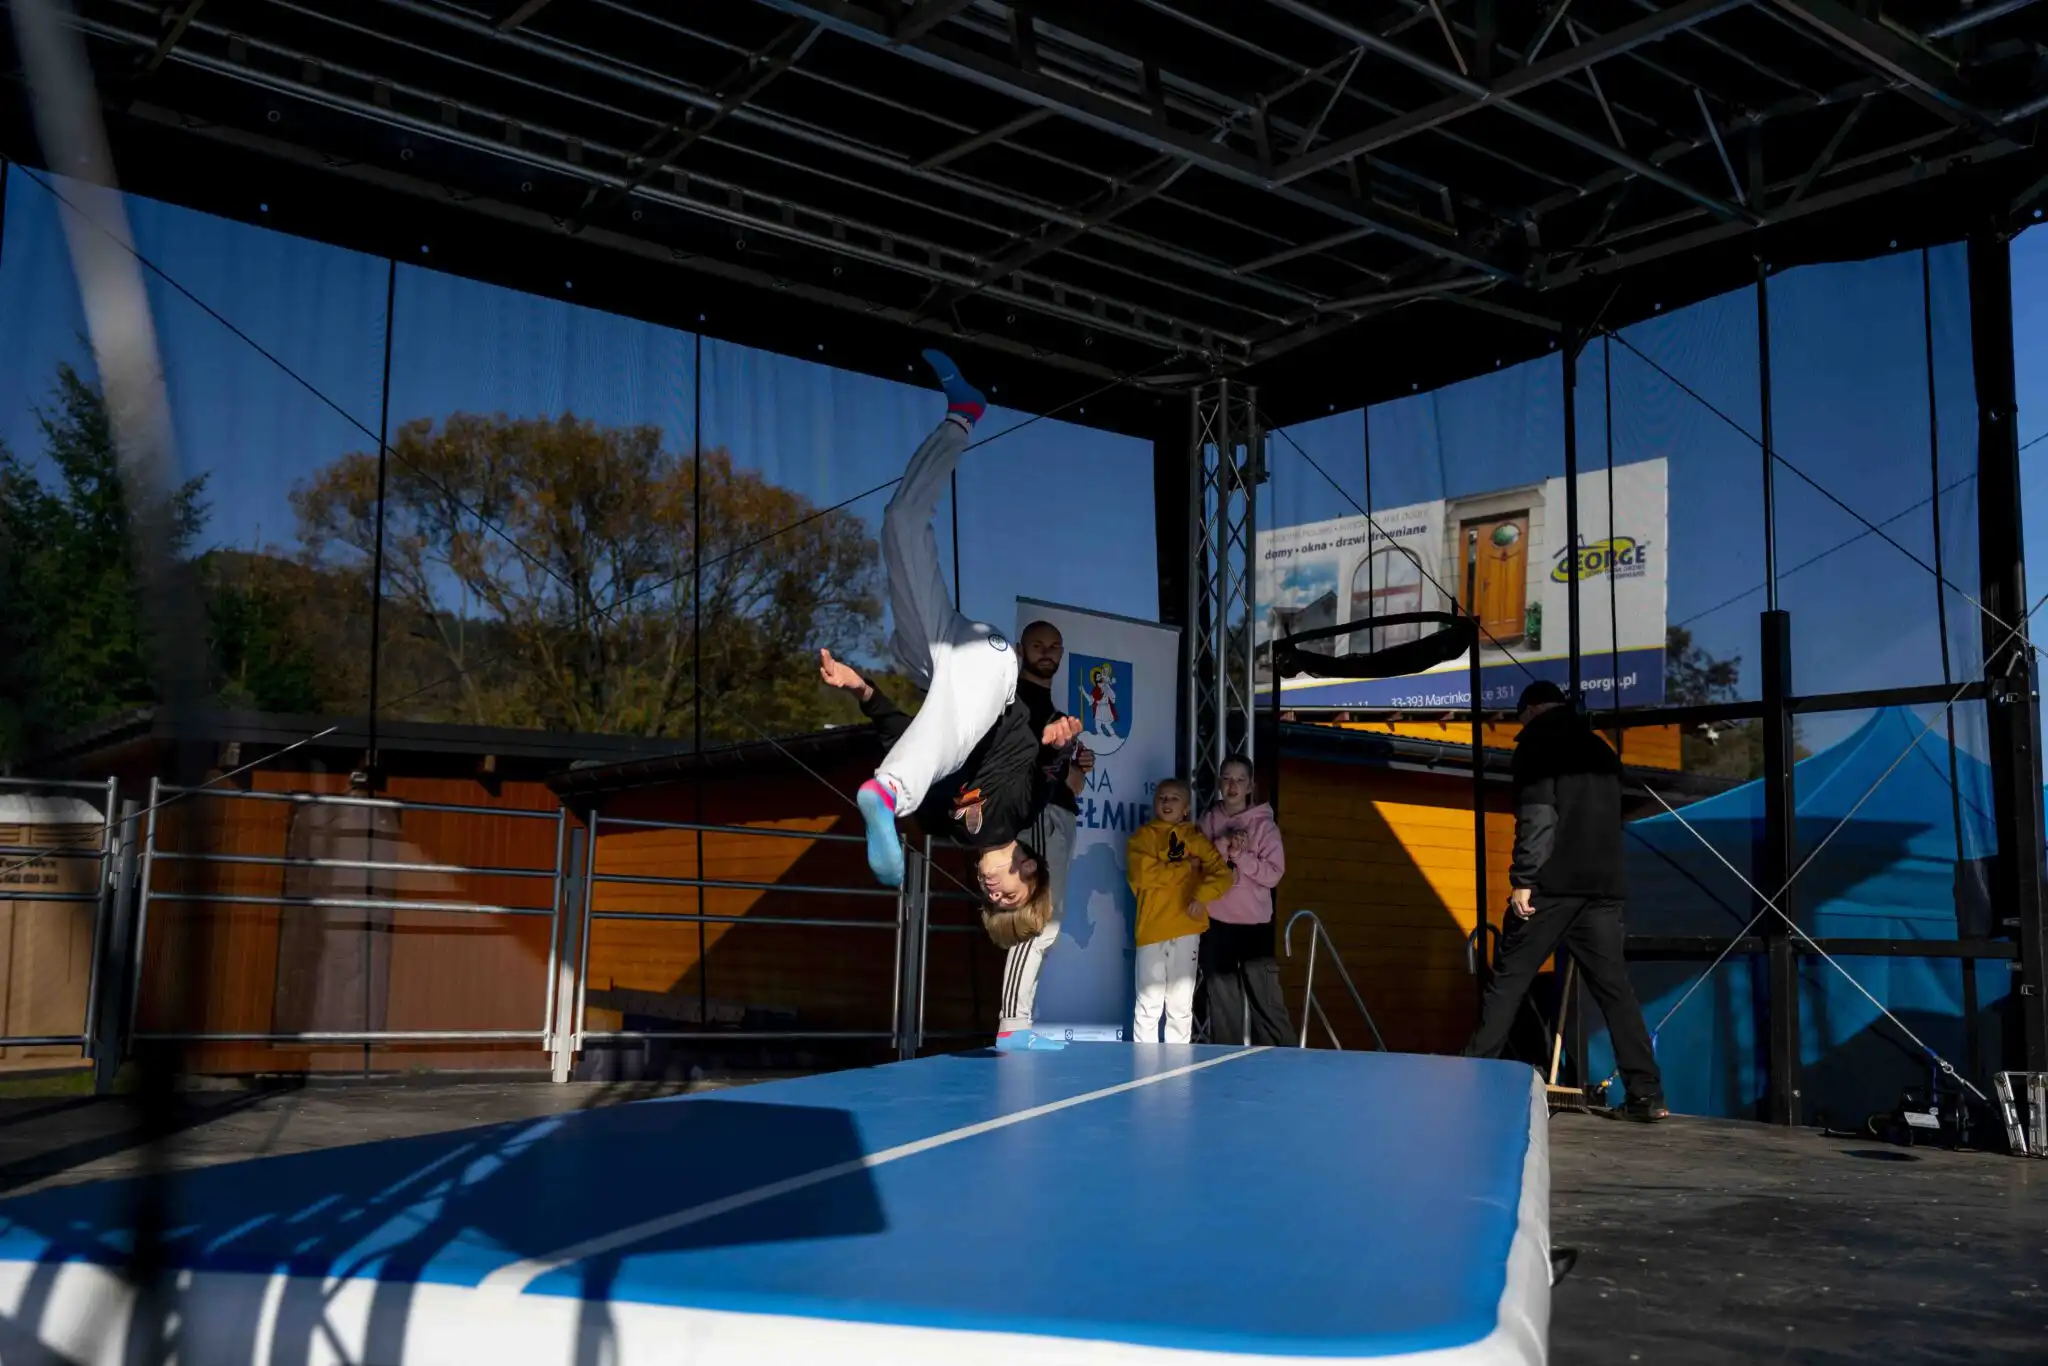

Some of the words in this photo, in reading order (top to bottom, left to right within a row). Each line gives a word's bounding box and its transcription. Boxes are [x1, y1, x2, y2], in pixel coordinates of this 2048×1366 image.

[1264, 547, 1293, 560] domy
[1301, 541, 1327, 554] okna
[1335, 532, 1366, 548] drzwi
[1085, 767, 1113, 794] NA
